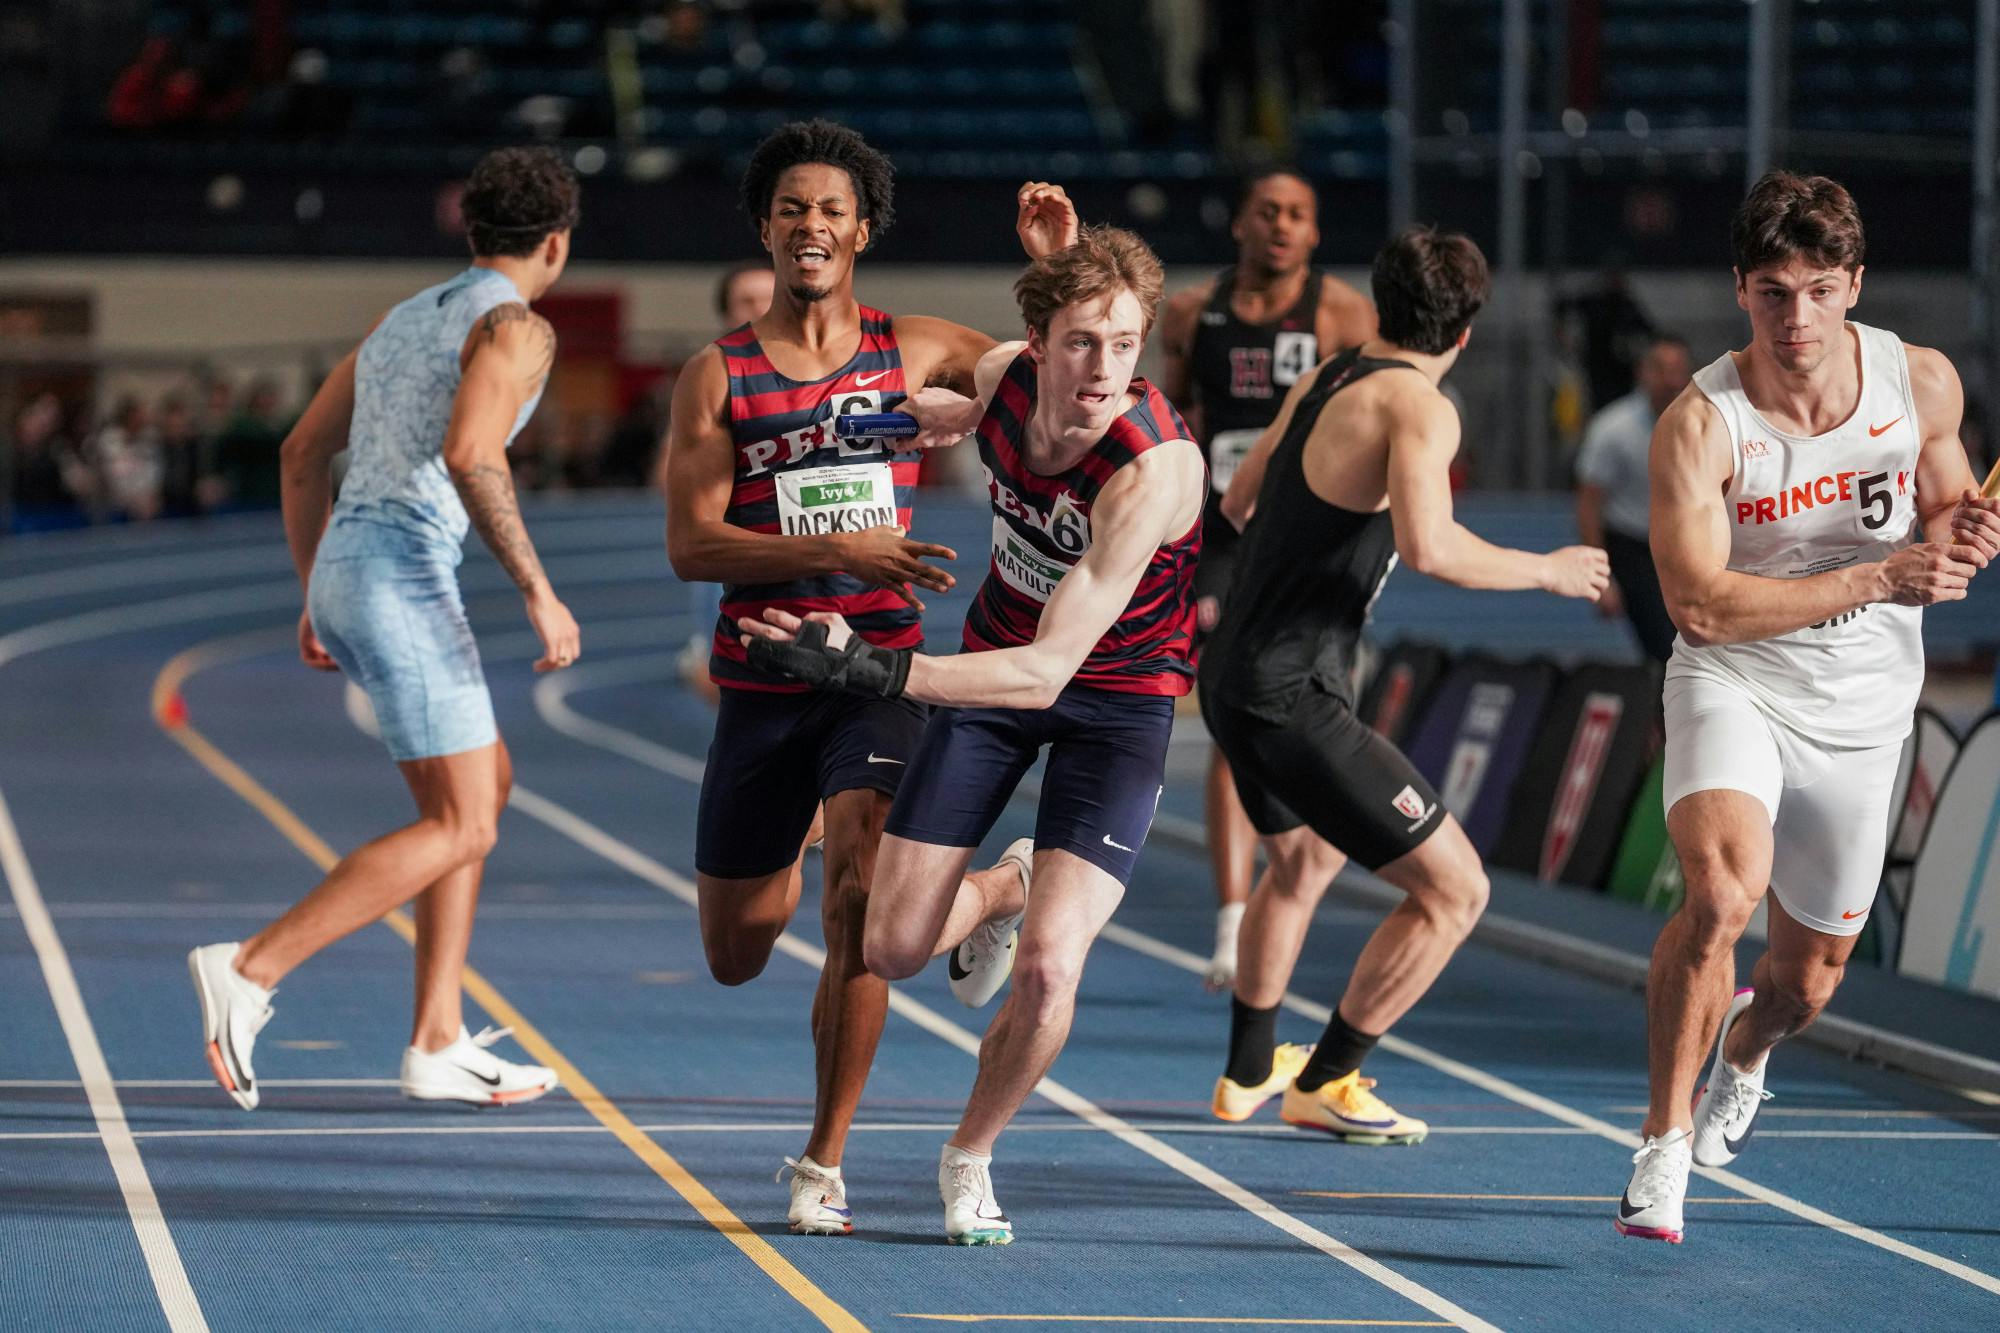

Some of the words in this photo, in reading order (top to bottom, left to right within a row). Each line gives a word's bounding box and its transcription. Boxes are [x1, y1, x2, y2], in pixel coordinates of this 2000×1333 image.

[1229, 347, 1273, 399] H
[1282, 342, 1303, 375] 4
[819, 487, 843, 502] Ivy
[1858, 471, 1893, 530] 5
[1053, 505, 1084, 552] 6
